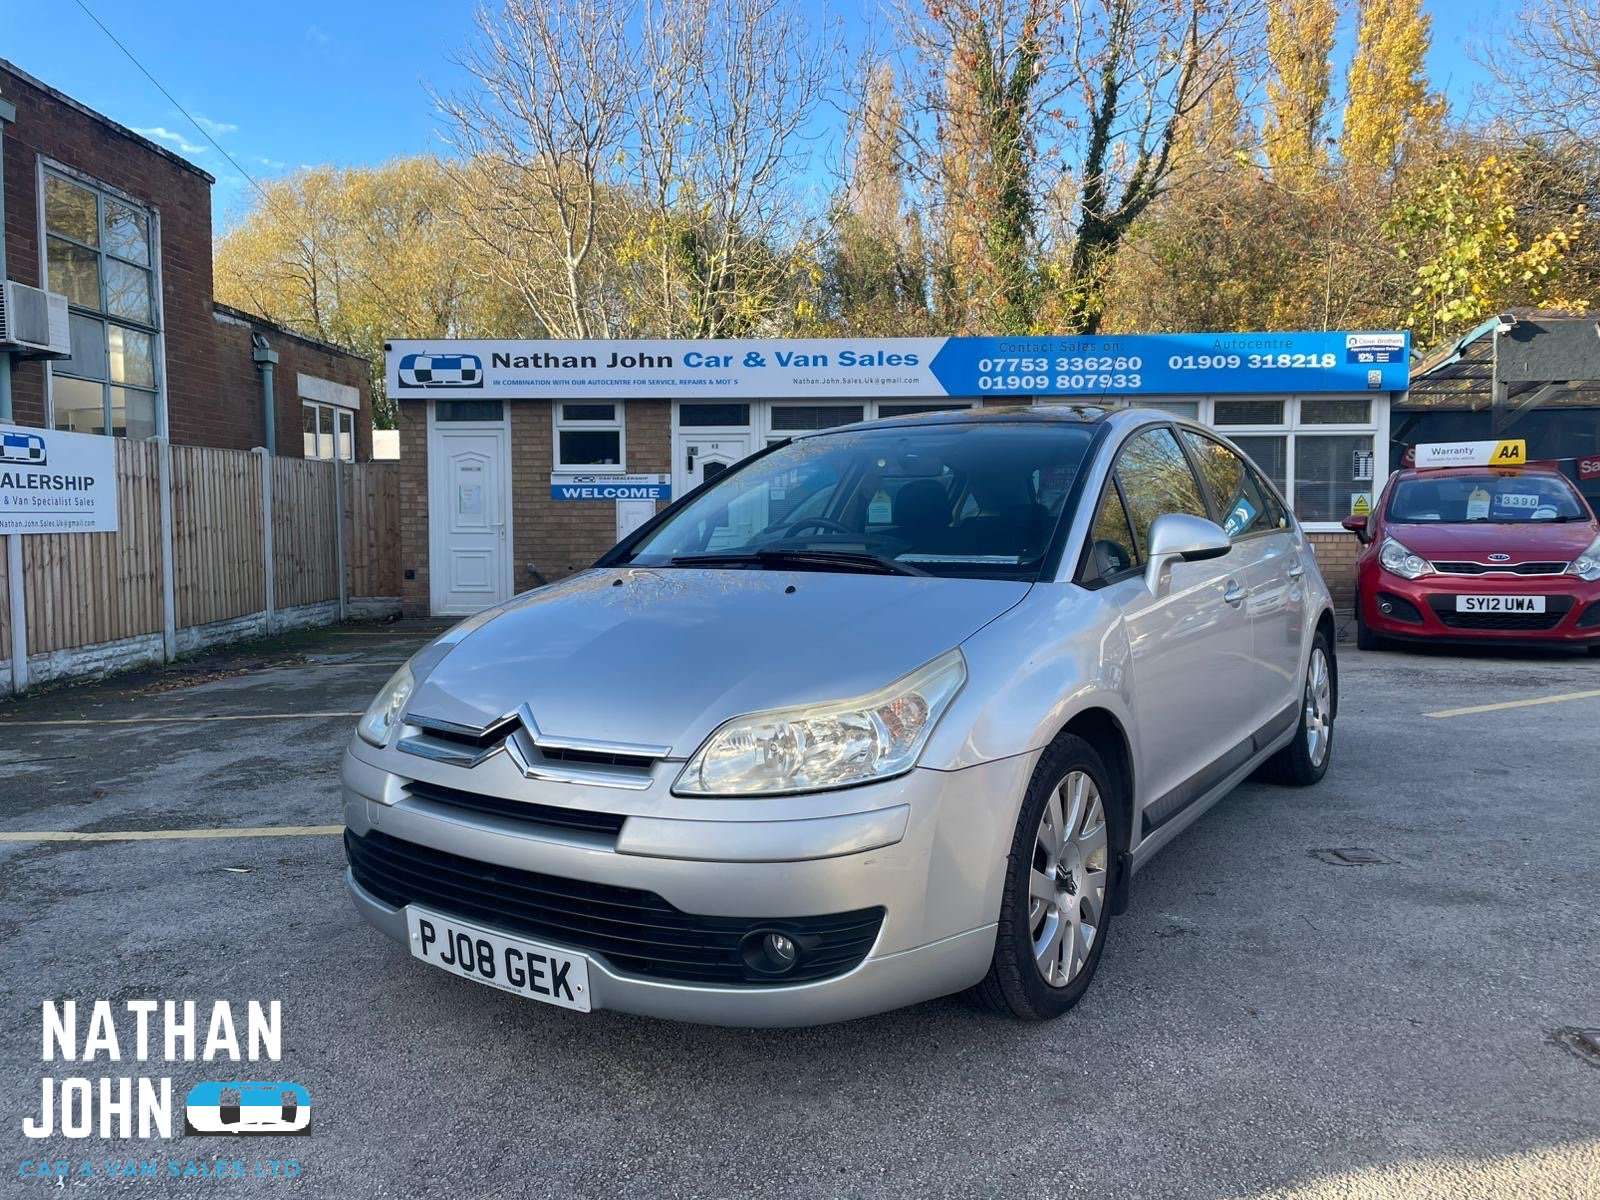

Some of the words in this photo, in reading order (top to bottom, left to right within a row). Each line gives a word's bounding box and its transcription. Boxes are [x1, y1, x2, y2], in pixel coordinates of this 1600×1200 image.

[1000, 342, 1052, 352] Contact
[1060, 341, 1096, 351] Sales
[1214, 339, 1293, 350] Autocentre
[491, 352, 597, 369] Nathan
[606, 352, 673, 369] John
[683, 351, 733, 368] Car
[742, 351, 766, 368] &
[774, 351, 828, 368] Van
[838, 350, 919, 367] Sales
[978, 358, 1049, 373] 07753
[1055, 356, 1143, 372] 336260
[1168, 354, 1241, 370] 01909
[1247, 353, 1337, 369] 318218
[978, 375, 1050, 390] 01909
[1055, 374, 1143, 389] 807933
[1432, 447, 1474, 456] Warranty
[1499, 445, 1519, 458] AA
[562, 487, 660, 498] WELCOME
[4, 495, 9, 505] &
[13, 496, 29, 505] Van
[32, 496, 71, 507] Specialist
[74, 497, 95, 506] Sales
[1466, 598, 1500, 610] SY12
[1505, 598, 1535, 610] UWA
[419, 918, 496, 979] PJ08
[504, 947, 575, 1002] GEK
